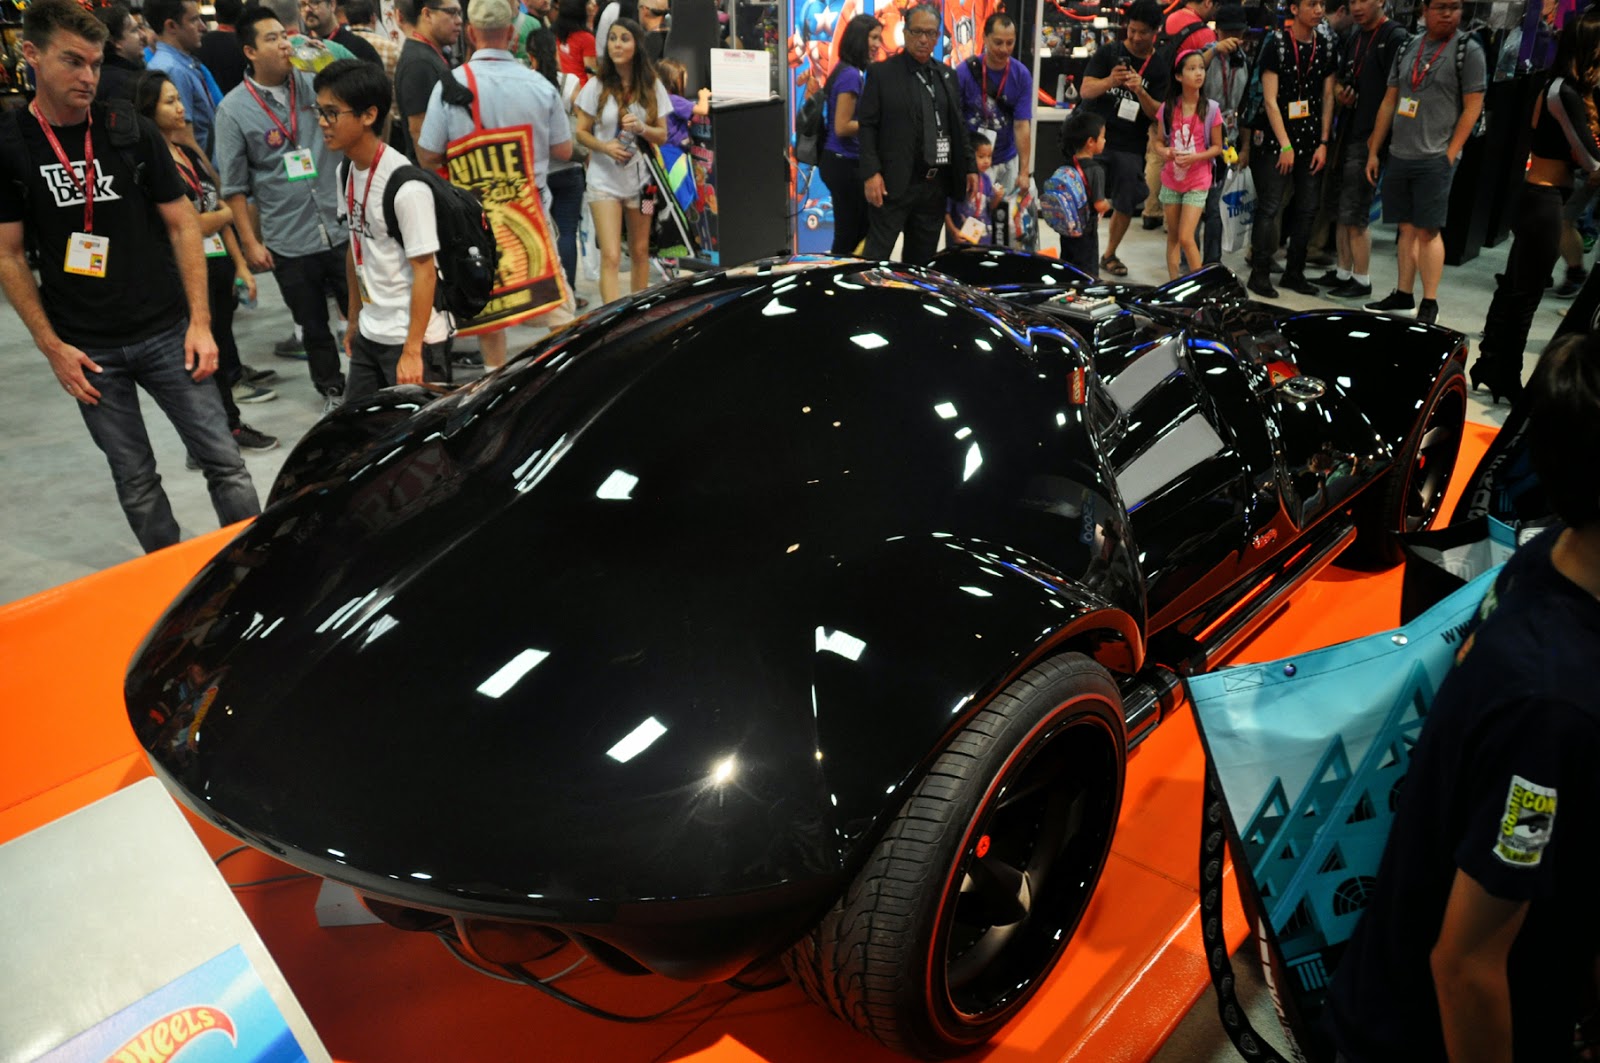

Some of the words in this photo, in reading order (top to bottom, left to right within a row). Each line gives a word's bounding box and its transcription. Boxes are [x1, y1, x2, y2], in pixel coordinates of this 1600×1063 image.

[450, 142, 522, 184] VILLE
[1502, 784, 1523, 836] COMIC
[1521, 791, 1556, 815] CON
